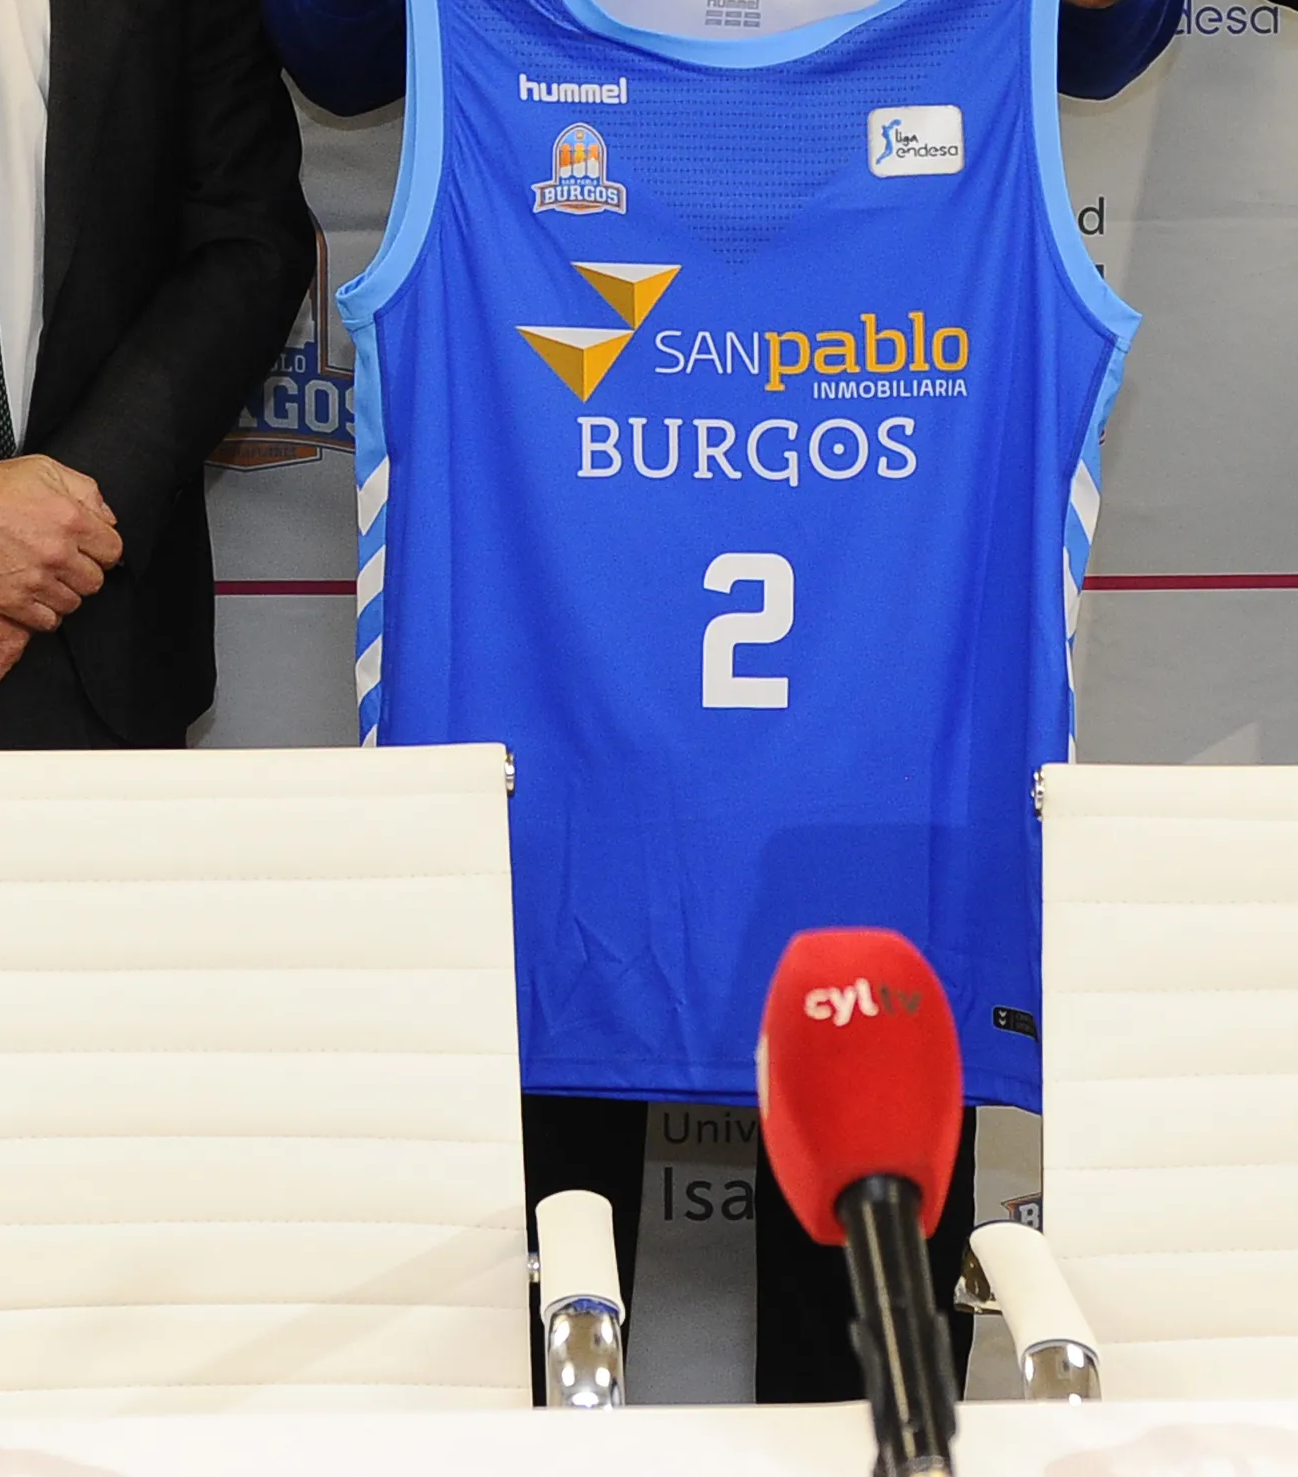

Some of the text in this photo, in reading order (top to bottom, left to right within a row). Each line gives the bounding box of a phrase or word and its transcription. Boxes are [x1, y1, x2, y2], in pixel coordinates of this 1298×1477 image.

[518, 73, 628, 105] hummel
[895, 143, 959, 159] endesa
[543, 184, 618, 205] BURGOS
[812, 379, 968, 400] INMOBILIARIA
[576, 415, 918, 488] BURGOS
[702, 551, 796, 709] 2
